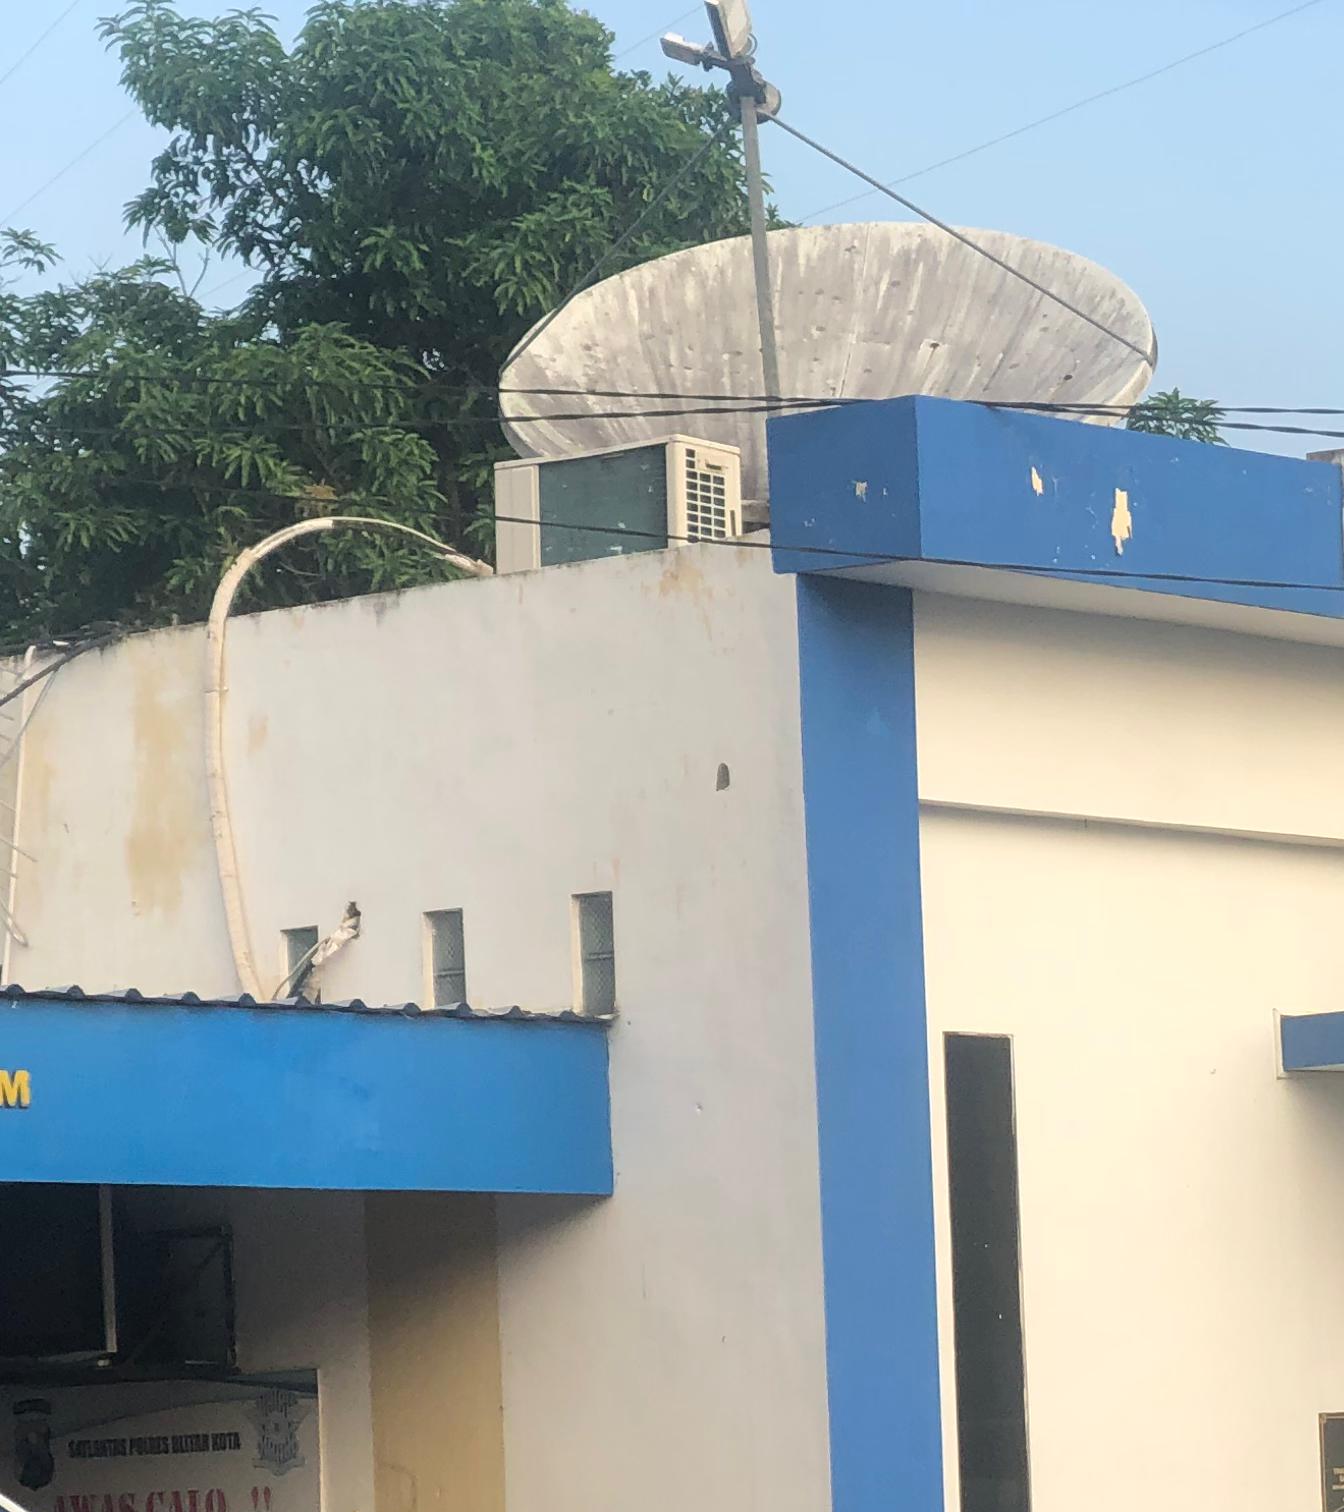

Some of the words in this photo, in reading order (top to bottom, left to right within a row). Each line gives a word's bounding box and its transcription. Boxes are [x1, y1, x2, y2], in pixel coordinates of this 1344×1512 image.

[68, 1438, 128, 1458] SATLANTAS
[129, 1437, 169, 1455] POLRES
[171, 1434, 210, 1453] BLITAR
[212, 1432, 241, 1450] KOTA
